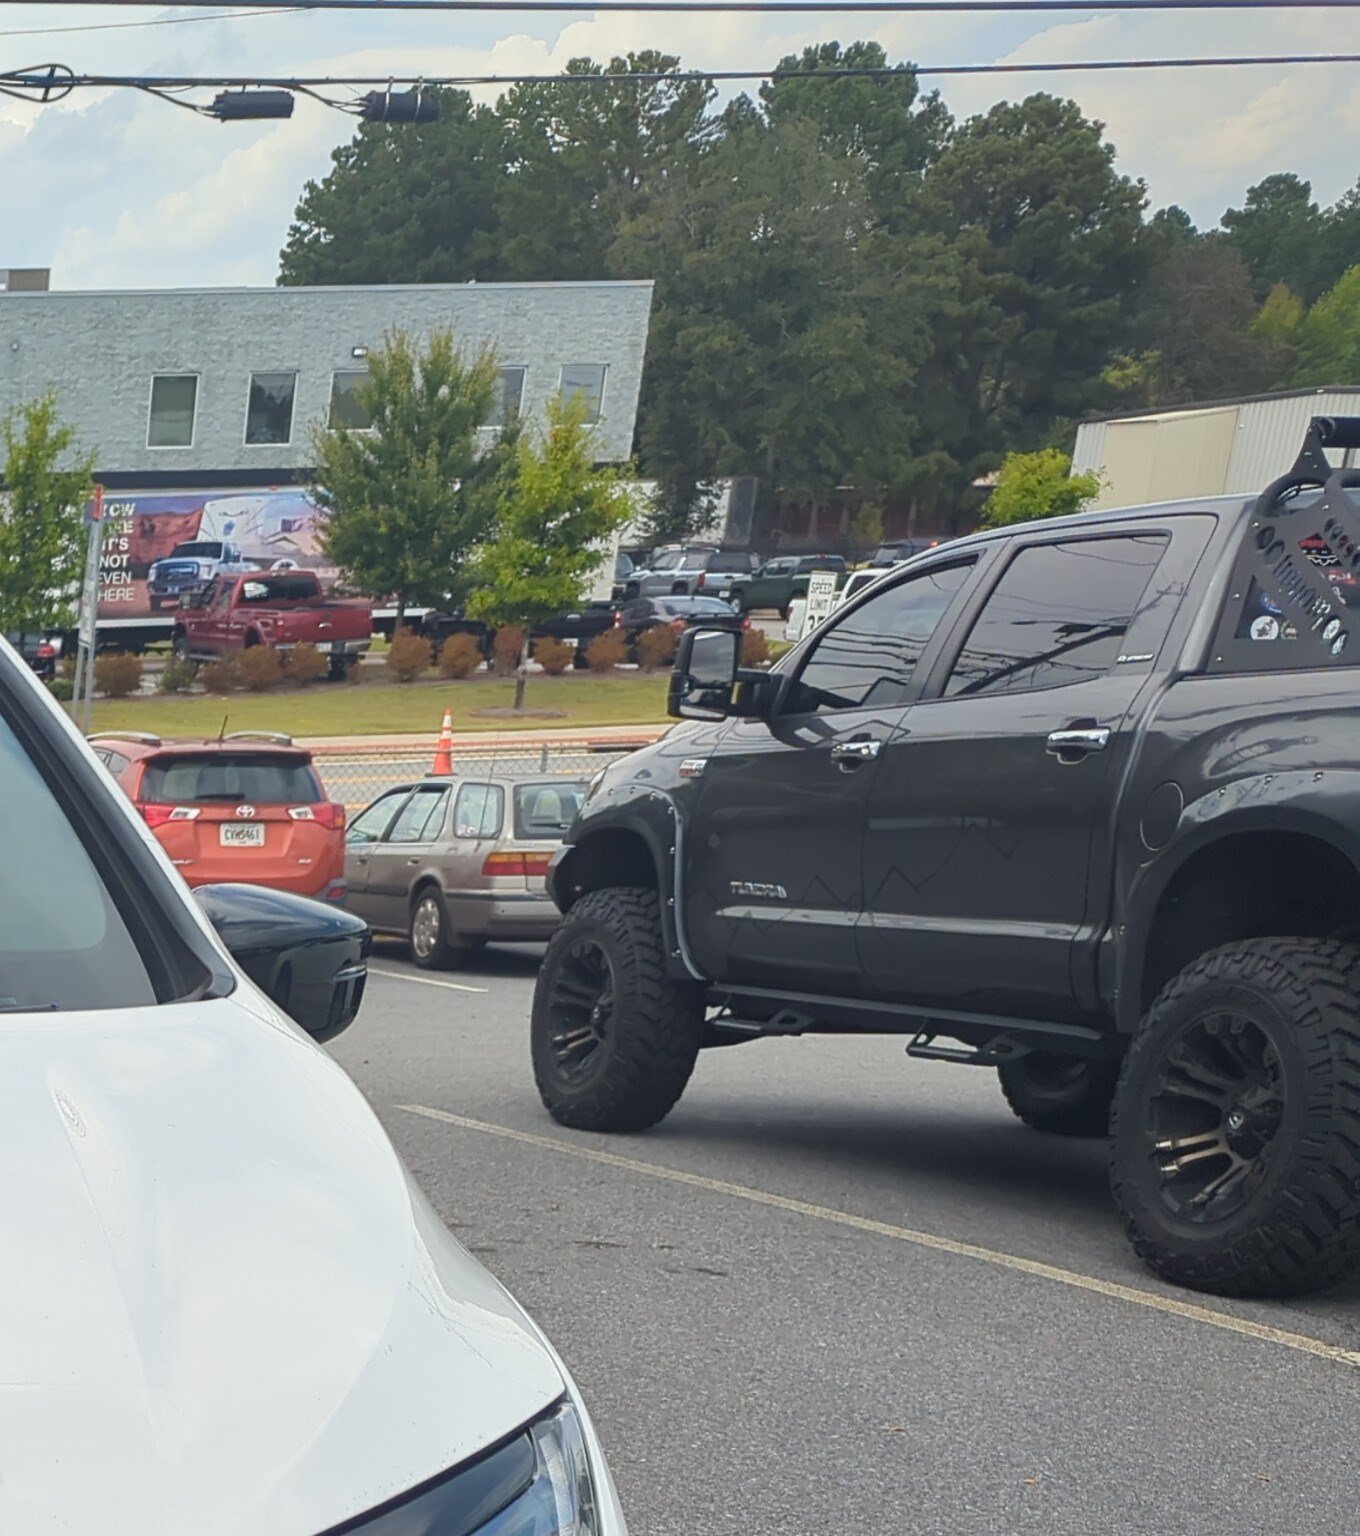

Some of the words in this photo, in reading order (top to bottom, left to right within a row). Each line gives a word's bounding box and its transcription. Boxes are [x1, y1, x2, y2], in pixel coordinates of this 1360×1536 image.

[100, 554, 130, 568] NOT
[811, 582, 833, 594] SPEED
[98, 588, 136, 601] HERE
[810, 599, 829, 611] LIMIT
